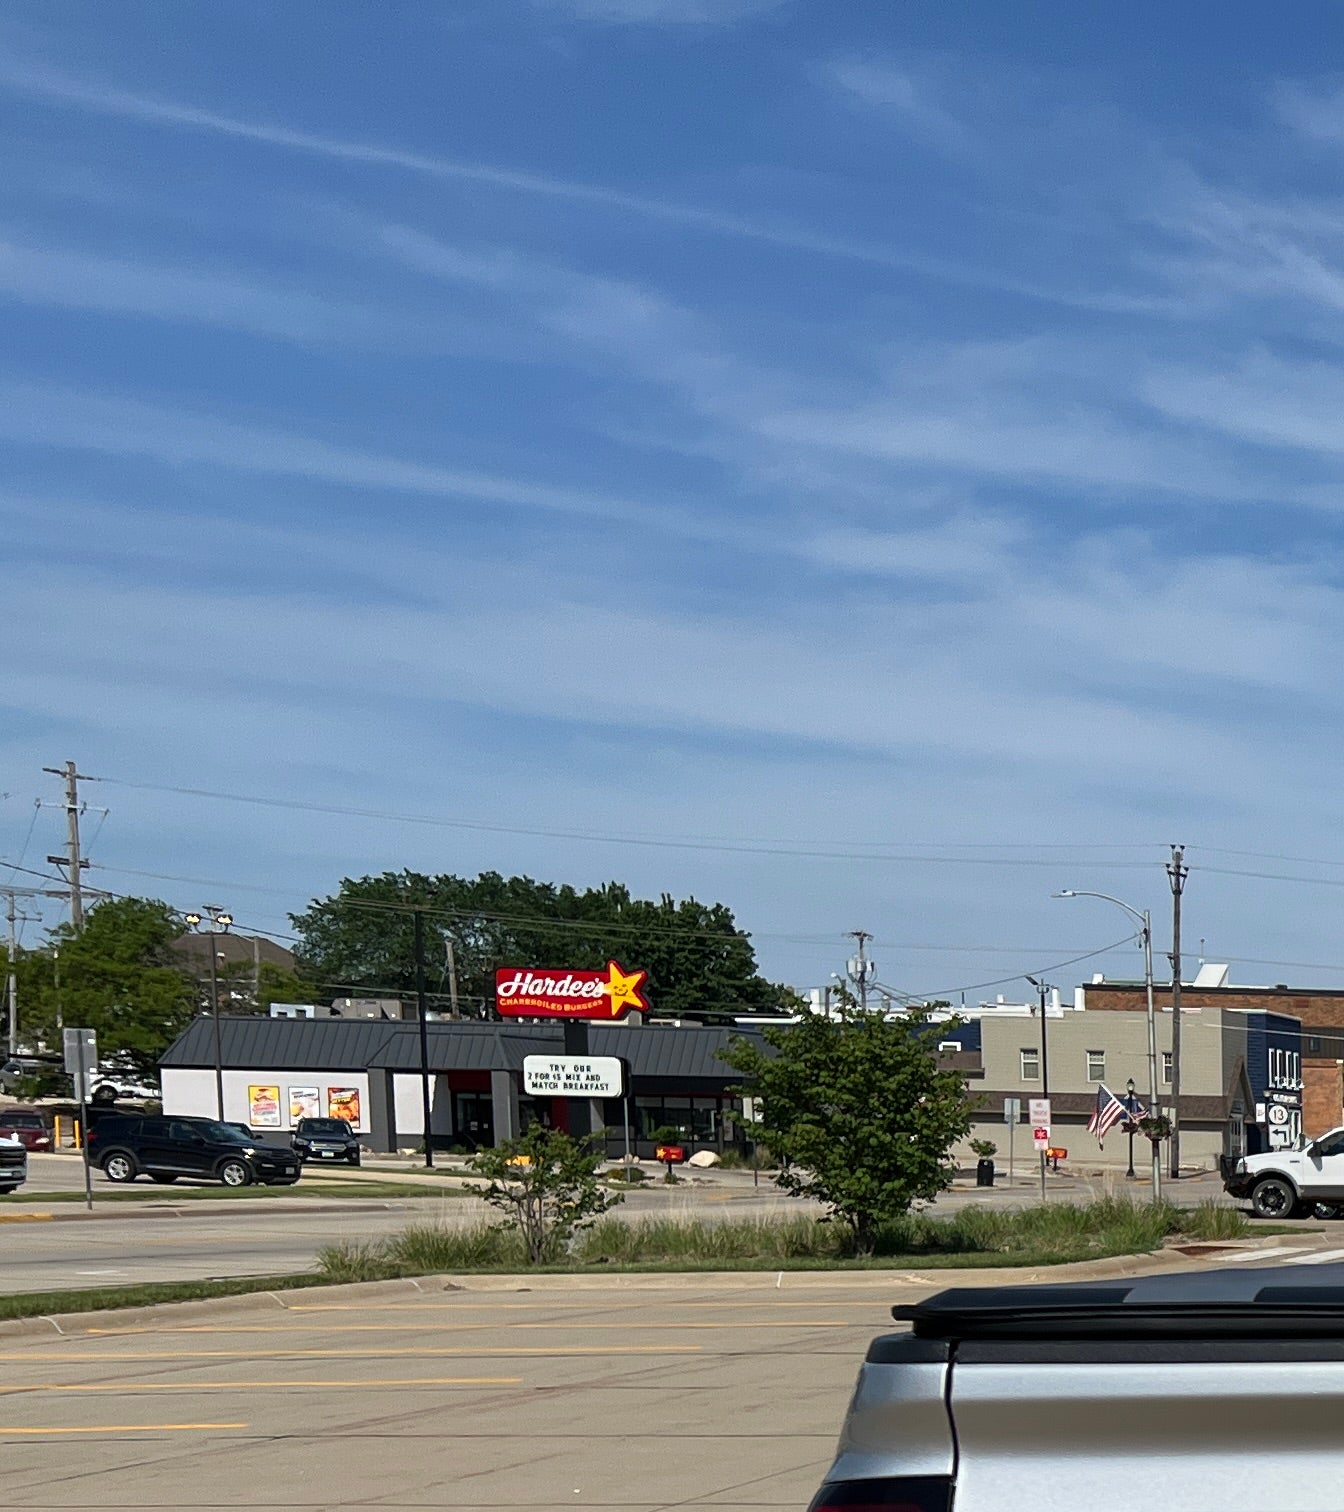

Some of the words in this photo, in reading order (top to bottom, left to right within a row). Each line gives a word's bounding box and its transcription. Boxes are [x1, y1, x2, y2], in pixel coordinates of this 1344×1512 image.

[497, 972, 605, 998] Hardee's
[549, 1064, 566, 1072] TRY
[574, 1065, 592, 1073] OUR
[534, 1072, 550, 1080] FOR
[532, 1082, 558, 1090] MATCH
[563, 1082, 609, 1091] BREAKFAST
[1273, 1110, 1284, 1121] 13
